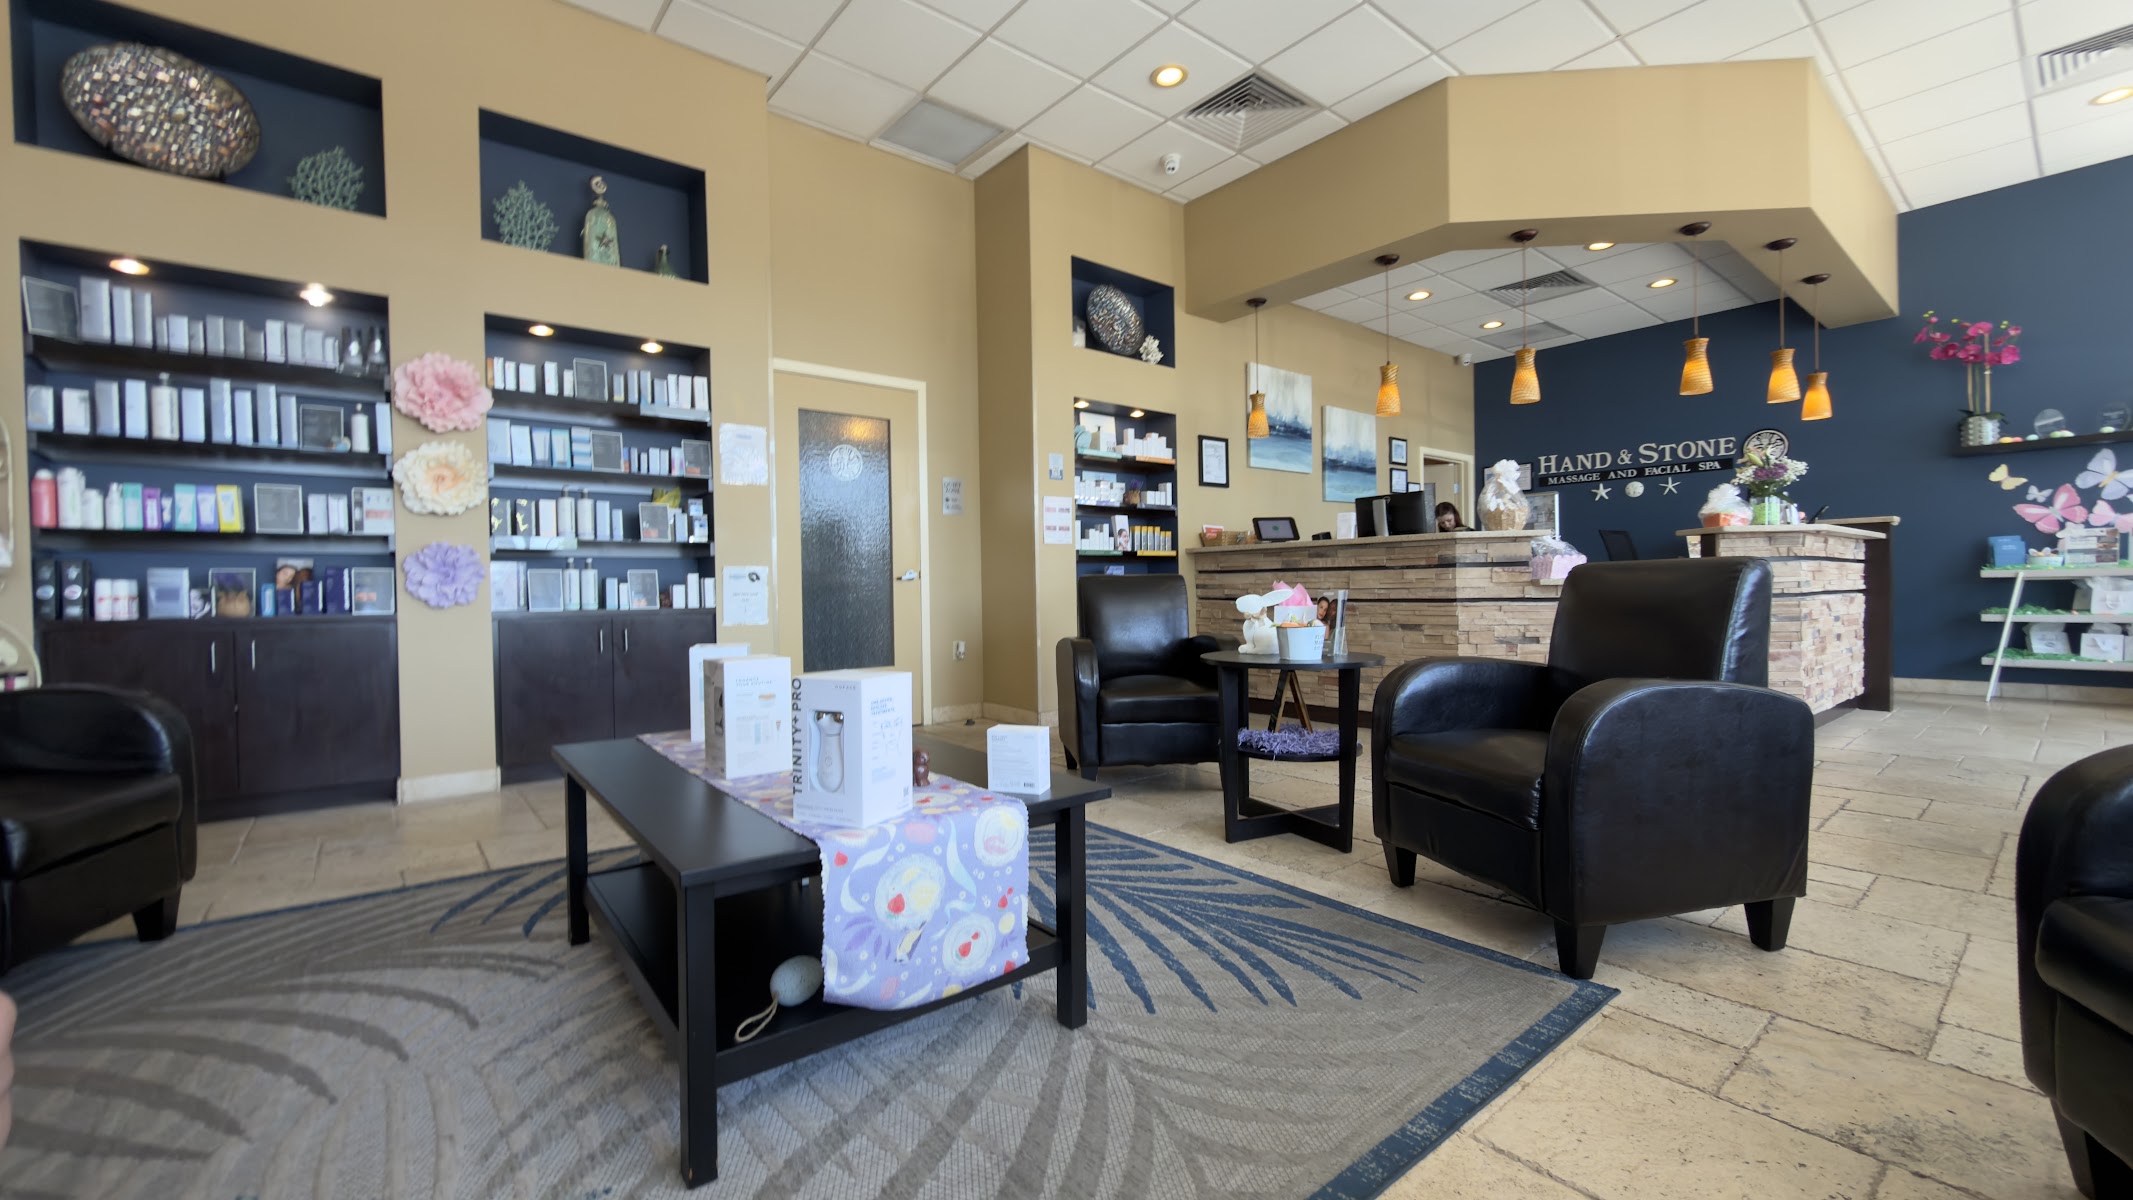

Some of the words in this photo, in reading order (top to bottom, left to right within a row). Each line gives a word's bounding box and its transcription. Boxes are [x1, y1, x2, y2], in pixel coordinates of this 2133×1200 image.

[1538, 452, 1612, 475] HAND
[1617, 449, 1633, 465] &
[1638, 437, 1737, 464] STONE
[1548, 473, 1601, 485] MASSAGE
[1608, 469, 1638, 479] AND
[1645, 463, 1692, 476] FACIAL
[1698, 461, 1722, 471] SPA
